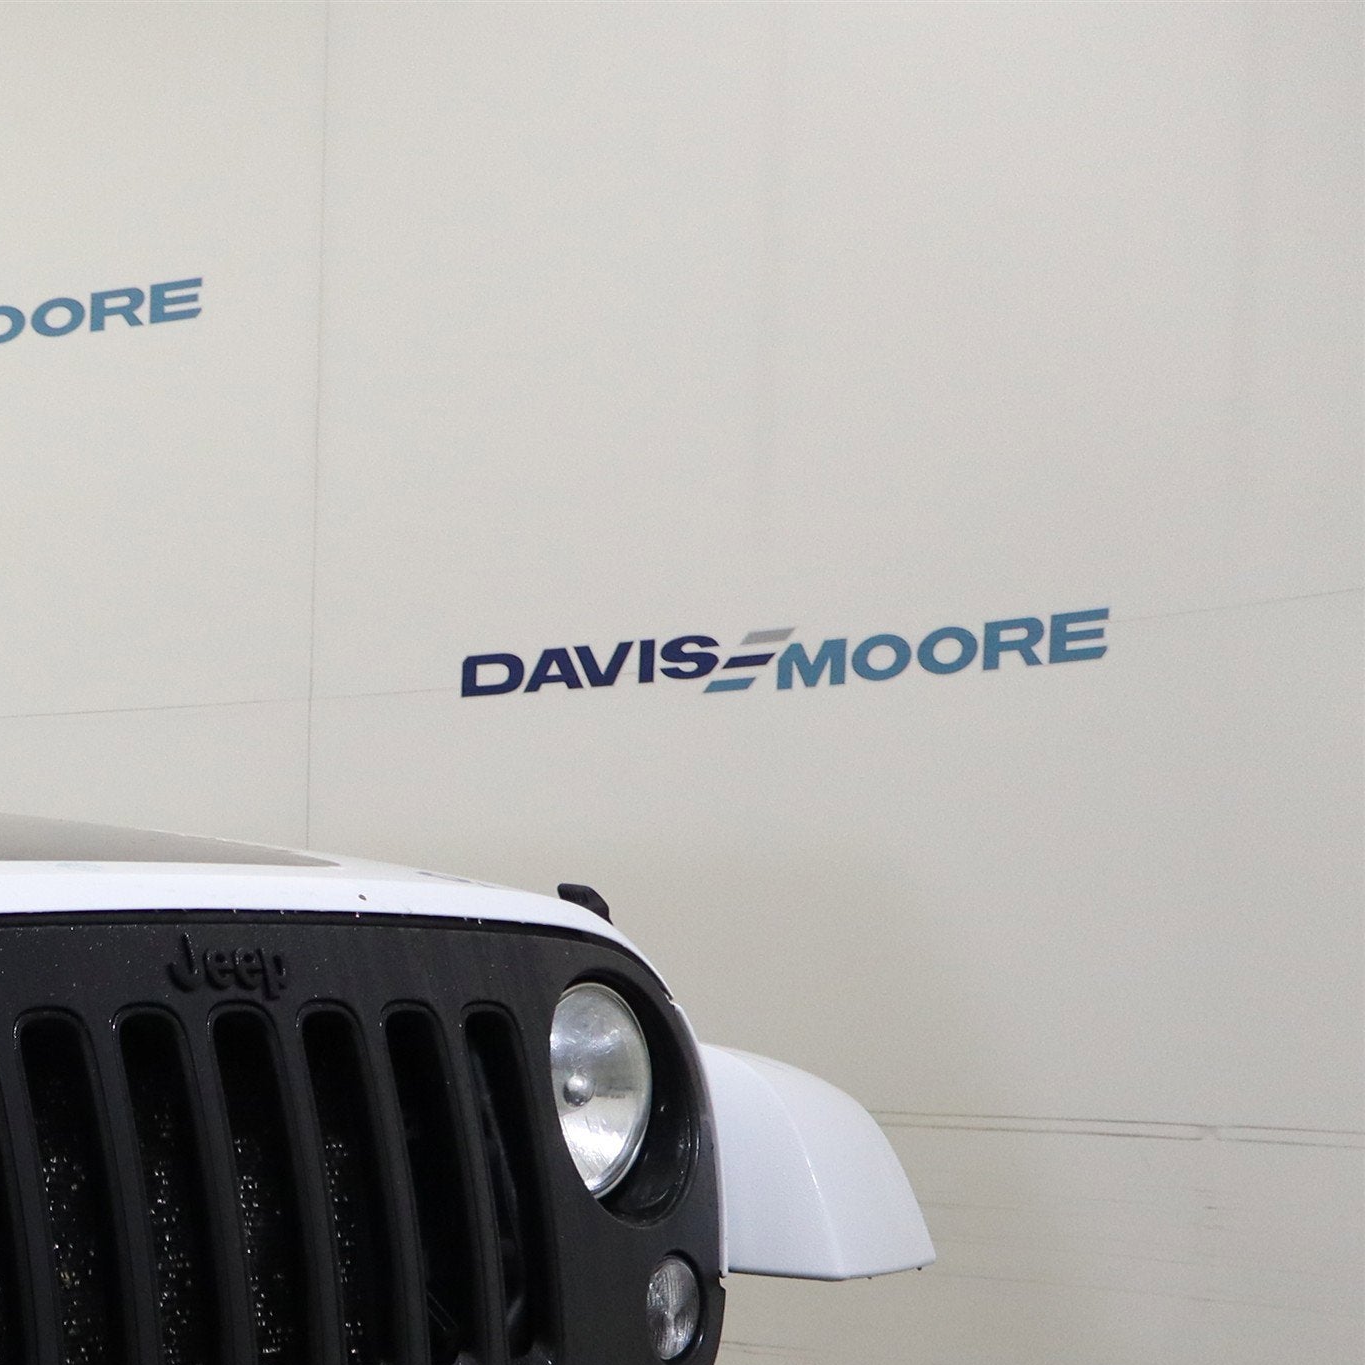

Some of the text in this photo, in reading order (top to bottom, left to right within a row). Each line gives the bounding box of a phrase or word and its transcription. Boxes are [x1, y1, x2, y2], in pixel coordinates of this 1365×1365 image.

[460, 607, 1110, 699] DAVIS MOORE
[166, 932, 288, 1001] Jeep
